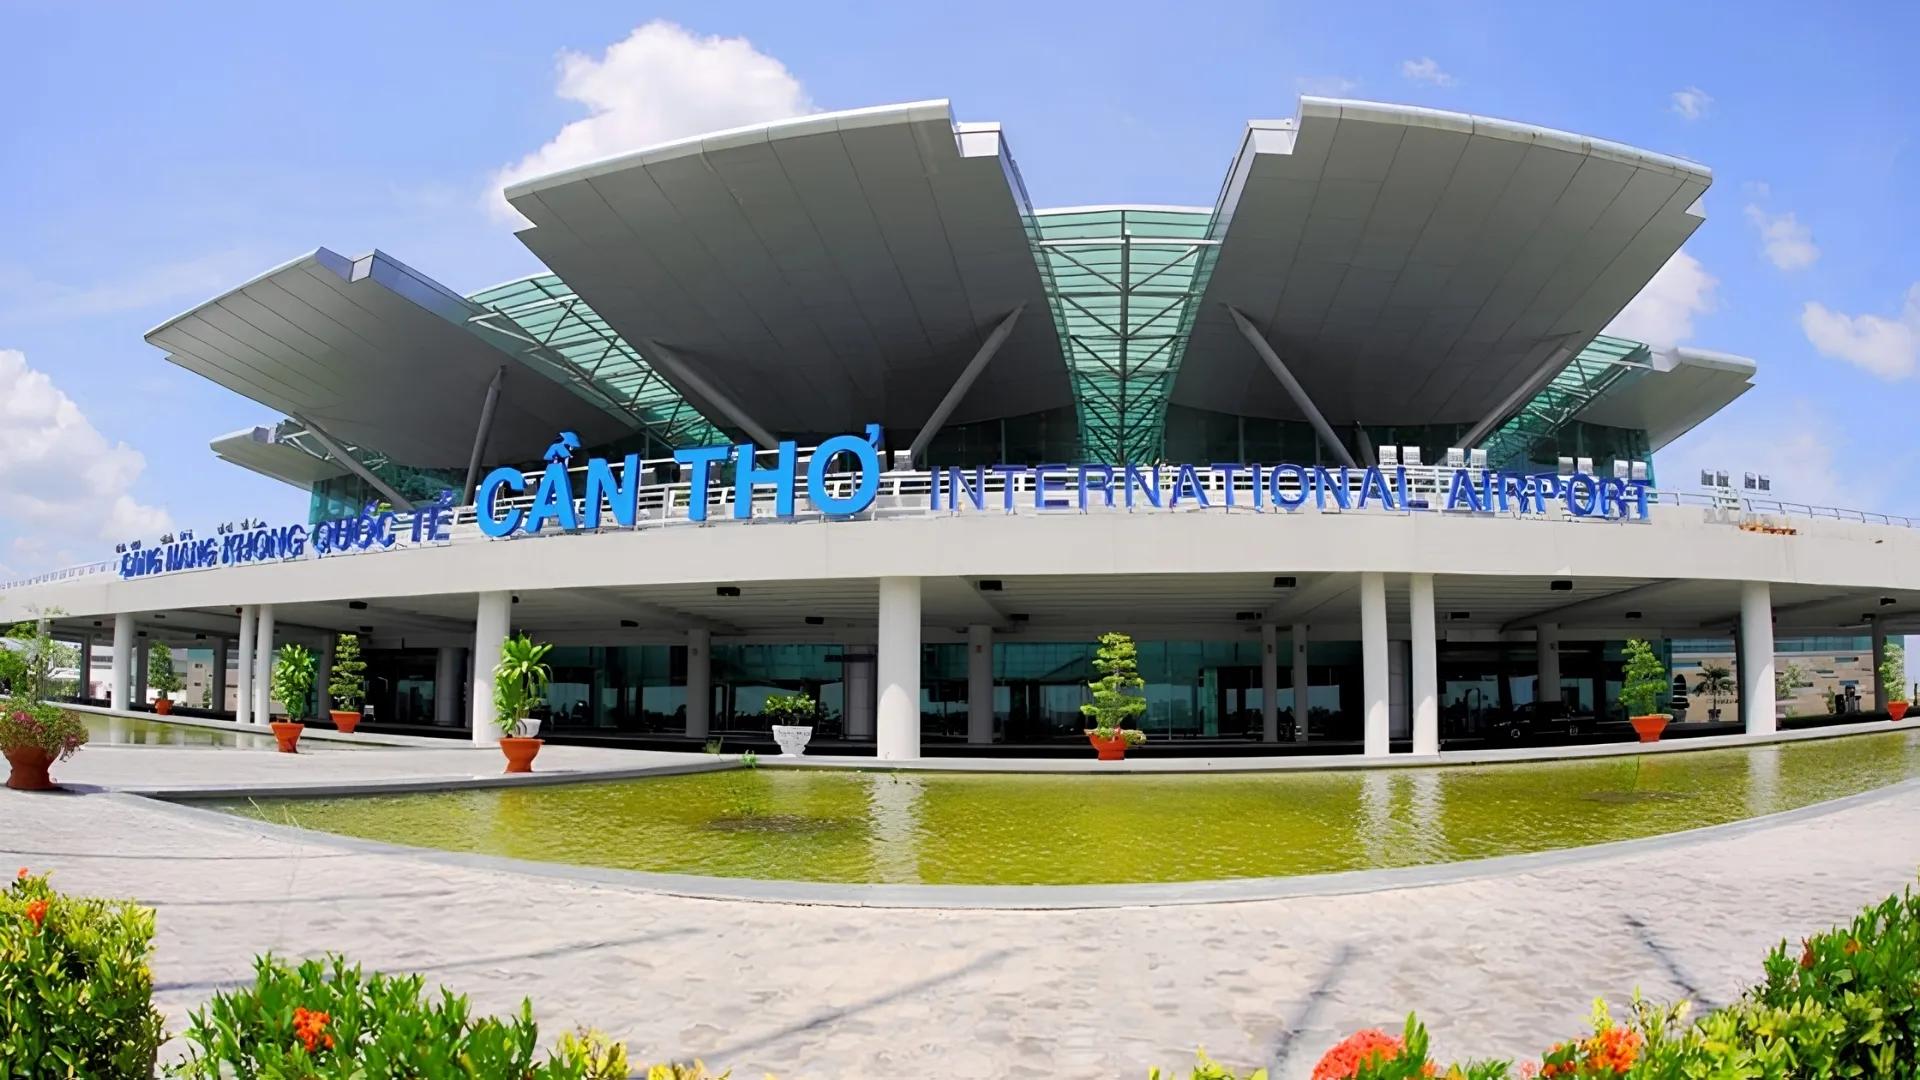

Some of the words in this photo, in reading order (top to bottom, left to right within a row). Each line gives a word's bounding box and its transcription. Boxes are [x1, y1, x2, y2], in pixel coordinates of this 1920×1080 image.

[311, 500, 399, 556] QUỐC
[406, 489, 453, 543] TẾ
[476, 431, 640, 538] CẦN
[674, 424, 885, 522] THƠ
[930, 463, 1428, 512] INTERNATIONAL
[1446, 468, 1651, 521] AIRPORT
